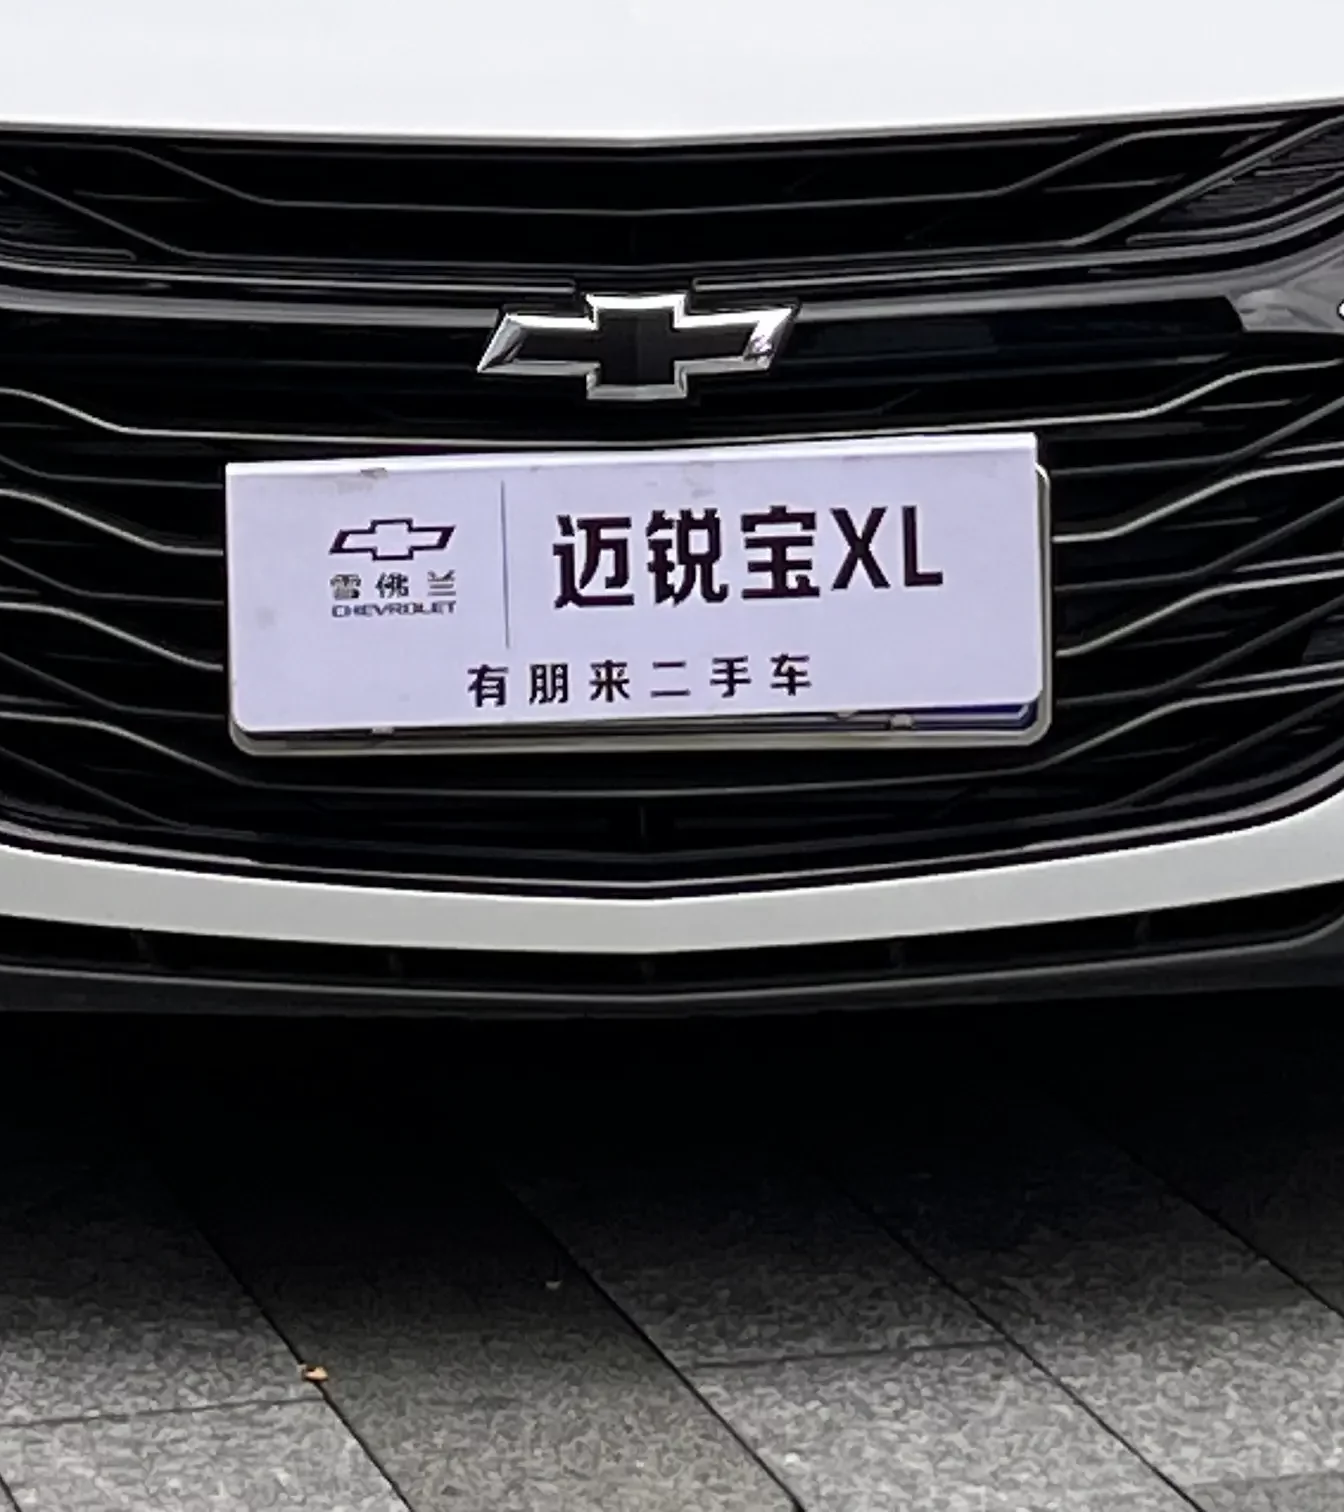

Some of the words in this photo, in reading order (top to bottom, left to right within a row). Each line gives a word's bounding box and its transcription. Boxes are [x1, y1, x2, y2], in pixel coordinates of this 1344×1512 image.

[553, 504, 944, 608] 迈锐宝XL
[466, 652, 812, 709] 有朋来二手车
